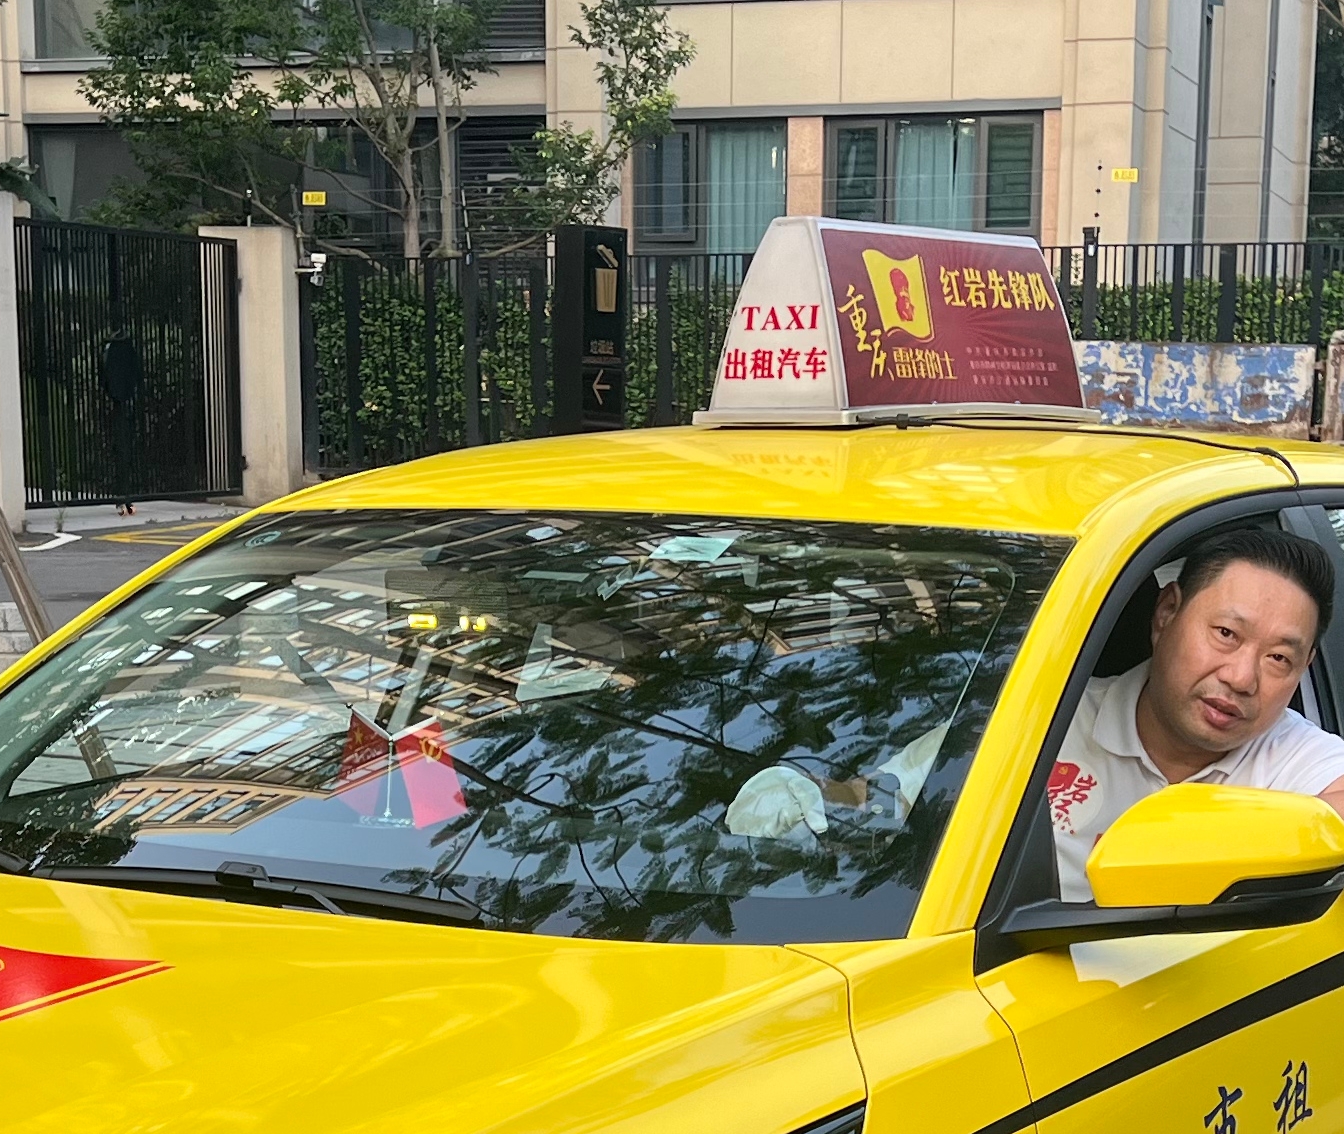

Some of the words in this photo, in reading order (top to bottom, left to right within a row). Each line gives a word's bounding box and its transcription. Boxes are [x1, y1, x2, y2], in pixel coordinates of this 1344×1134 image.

[939, 265, 1056, 311] 红岩先锋队
[741, 305, 820, 330] TAXI
[724, 347, 827, 380] 出租汽车
[892, 346, 958, 381] 雷锋的士
